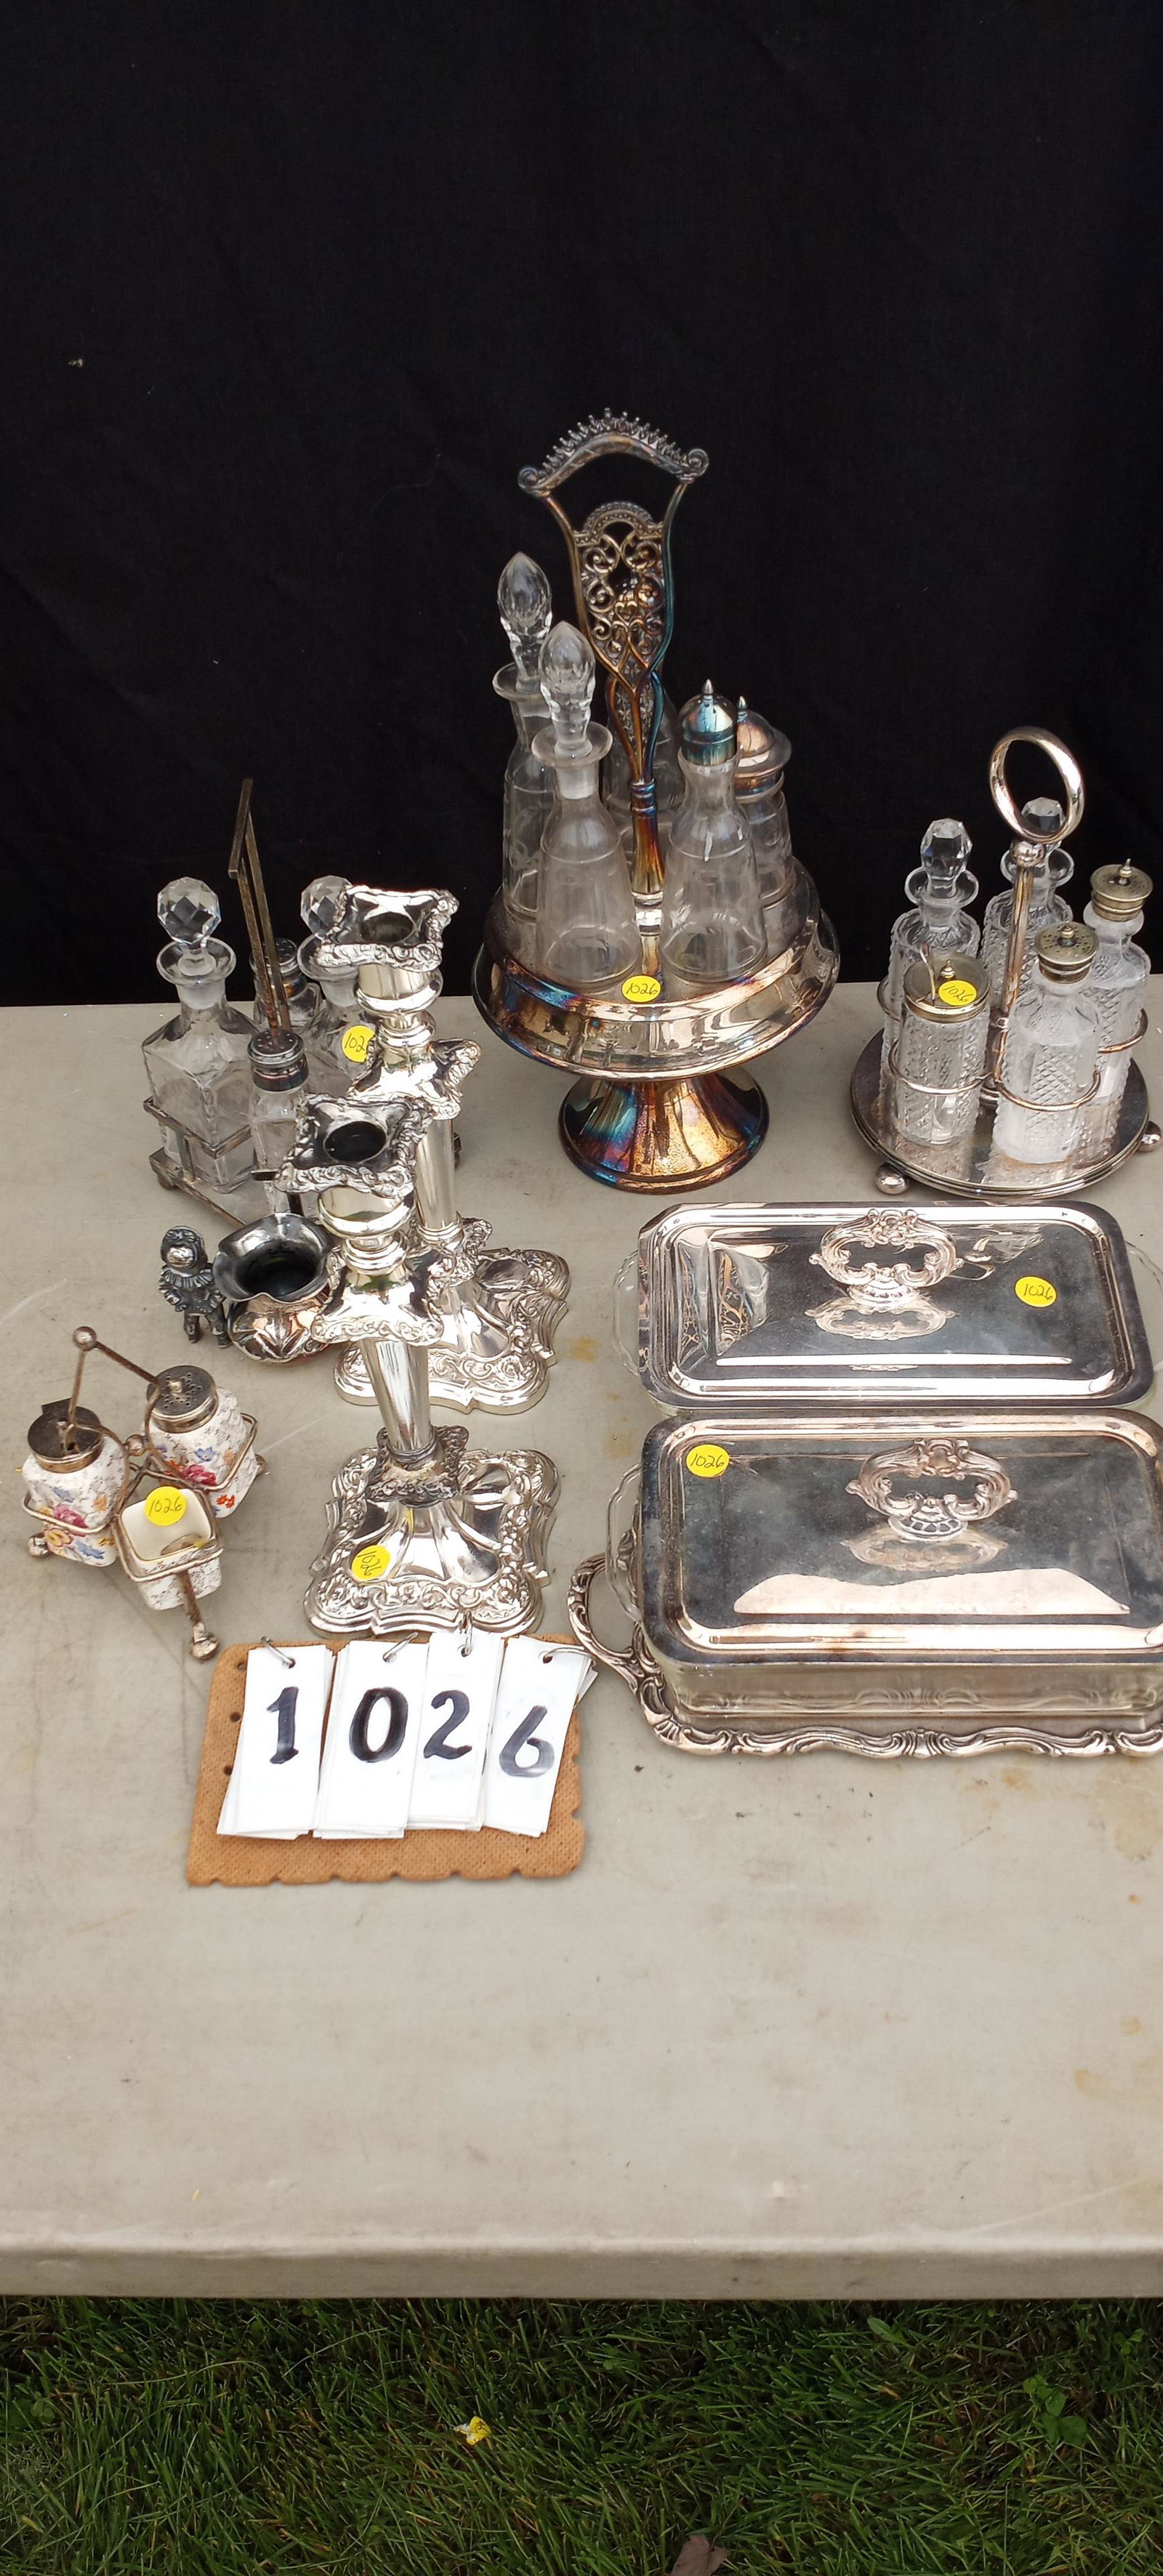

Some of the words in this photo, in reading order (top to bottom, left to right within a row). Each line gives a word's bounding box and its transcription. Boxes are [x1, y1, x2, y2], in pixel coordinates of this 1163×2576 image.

[625, 982, 659, 996] 1026
[942, 985, 974, 1003] 1026
[344, 1033, 366, 1053] 102
[1023, 1283, 1054, 1301] 1026
[690, 1453, 725, 1469] 1026
[148, 1495, 183, 1518] 1026
[266, 1685, 555, 1779] 1026
